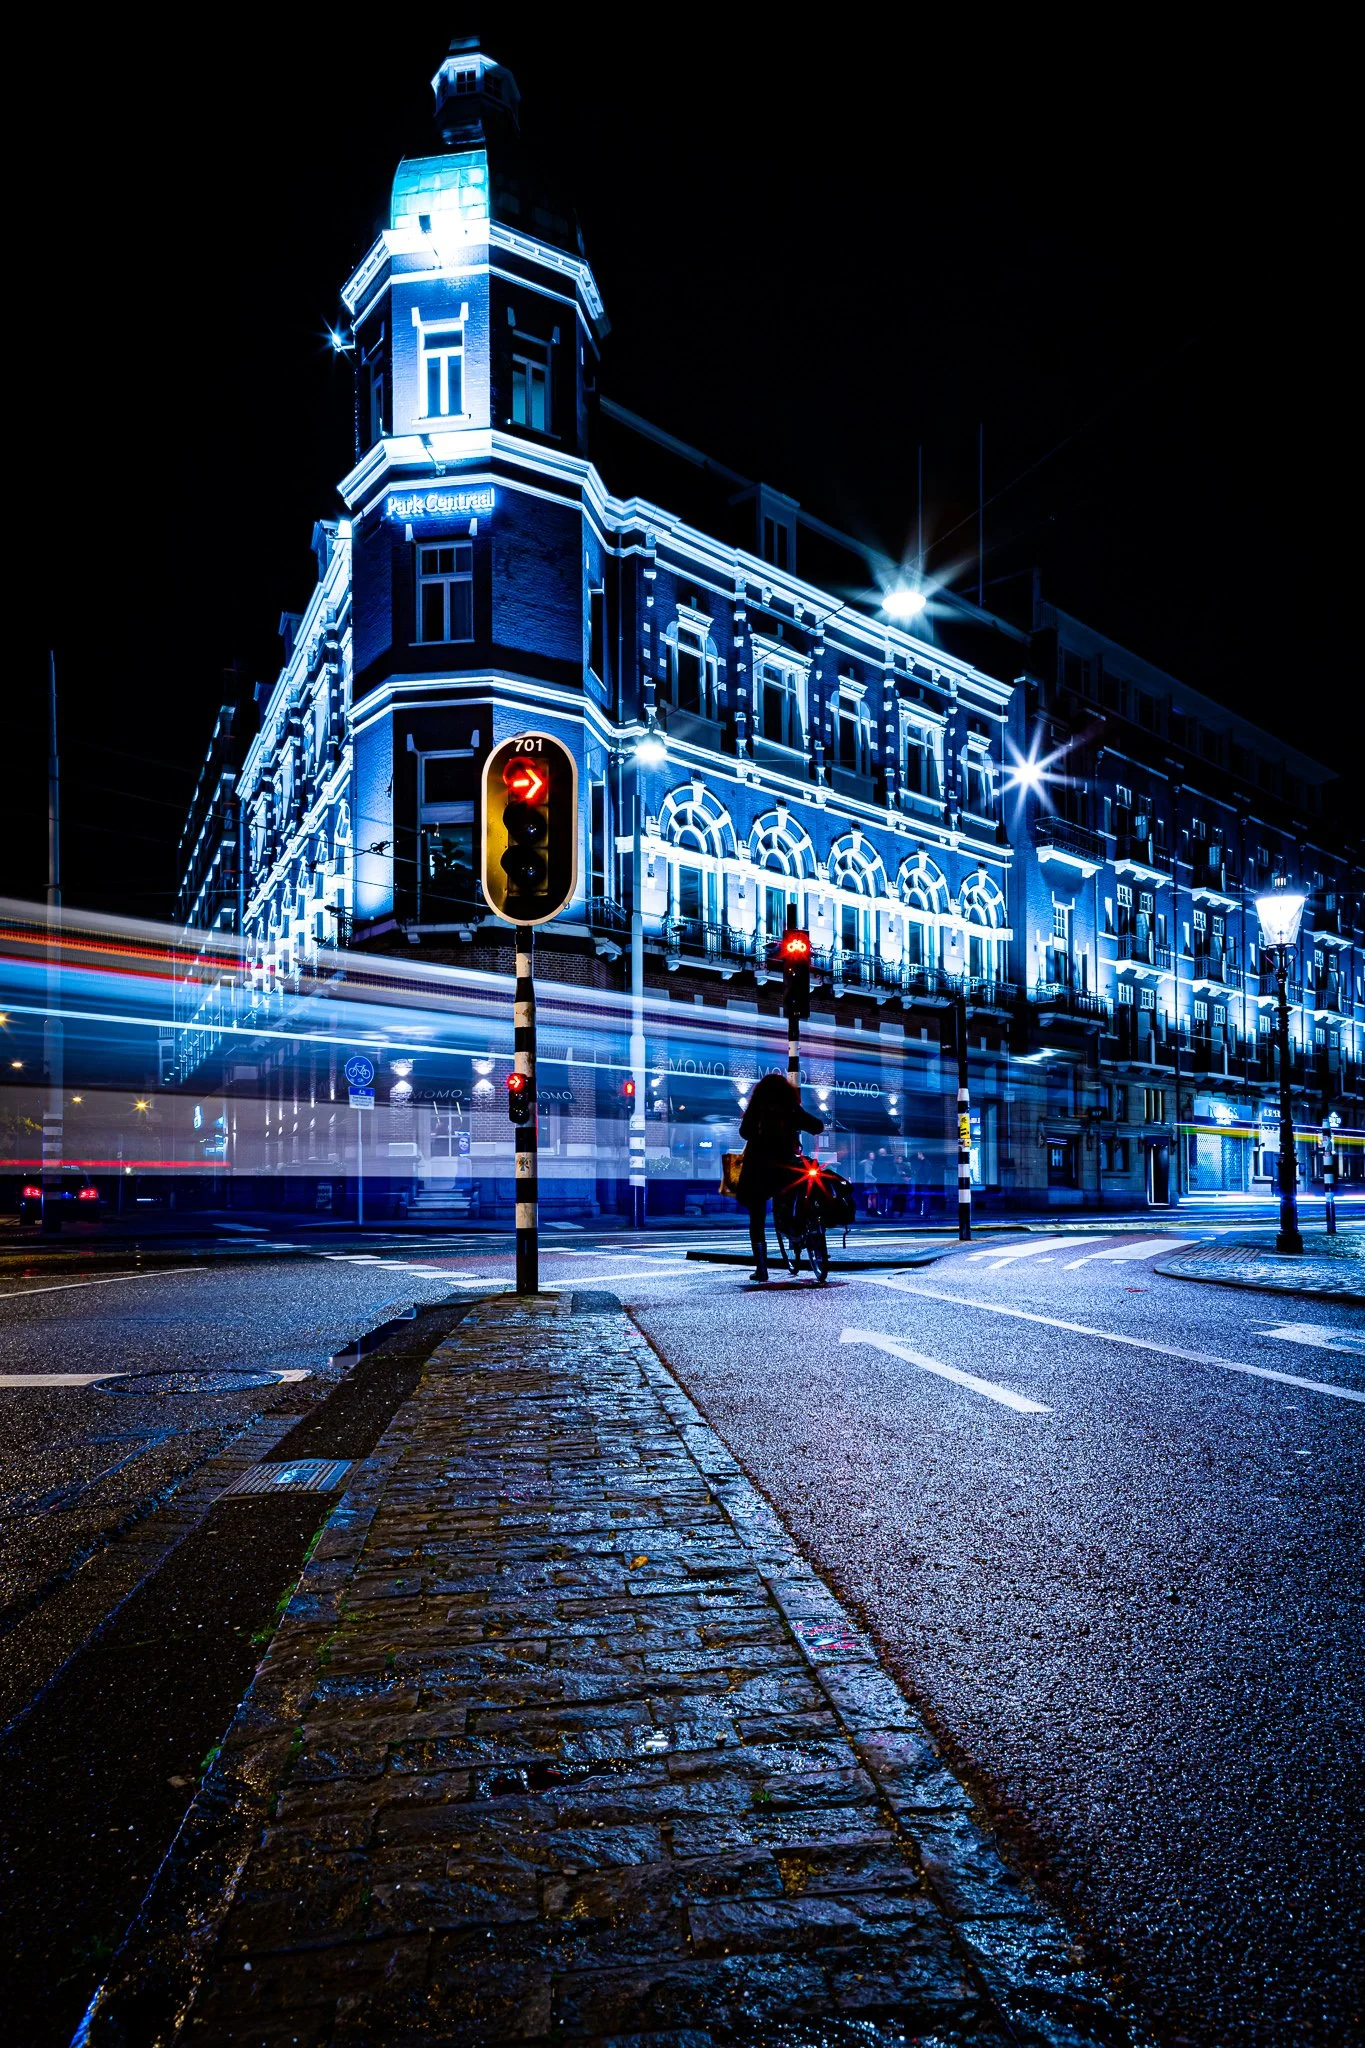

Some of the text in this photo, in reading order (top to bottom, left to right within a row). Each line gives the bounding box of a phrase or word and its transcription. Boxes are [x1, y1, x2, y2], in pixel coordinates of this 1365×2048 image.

[386, 487, 495, 516] Park Centraal
[514, 738, 543, 752] 701
[669, 1057, 726, 1077] MOMO
[411, 1089, 463, 1099] MOMO
[835, 1080, 880, 1099] MOMO
